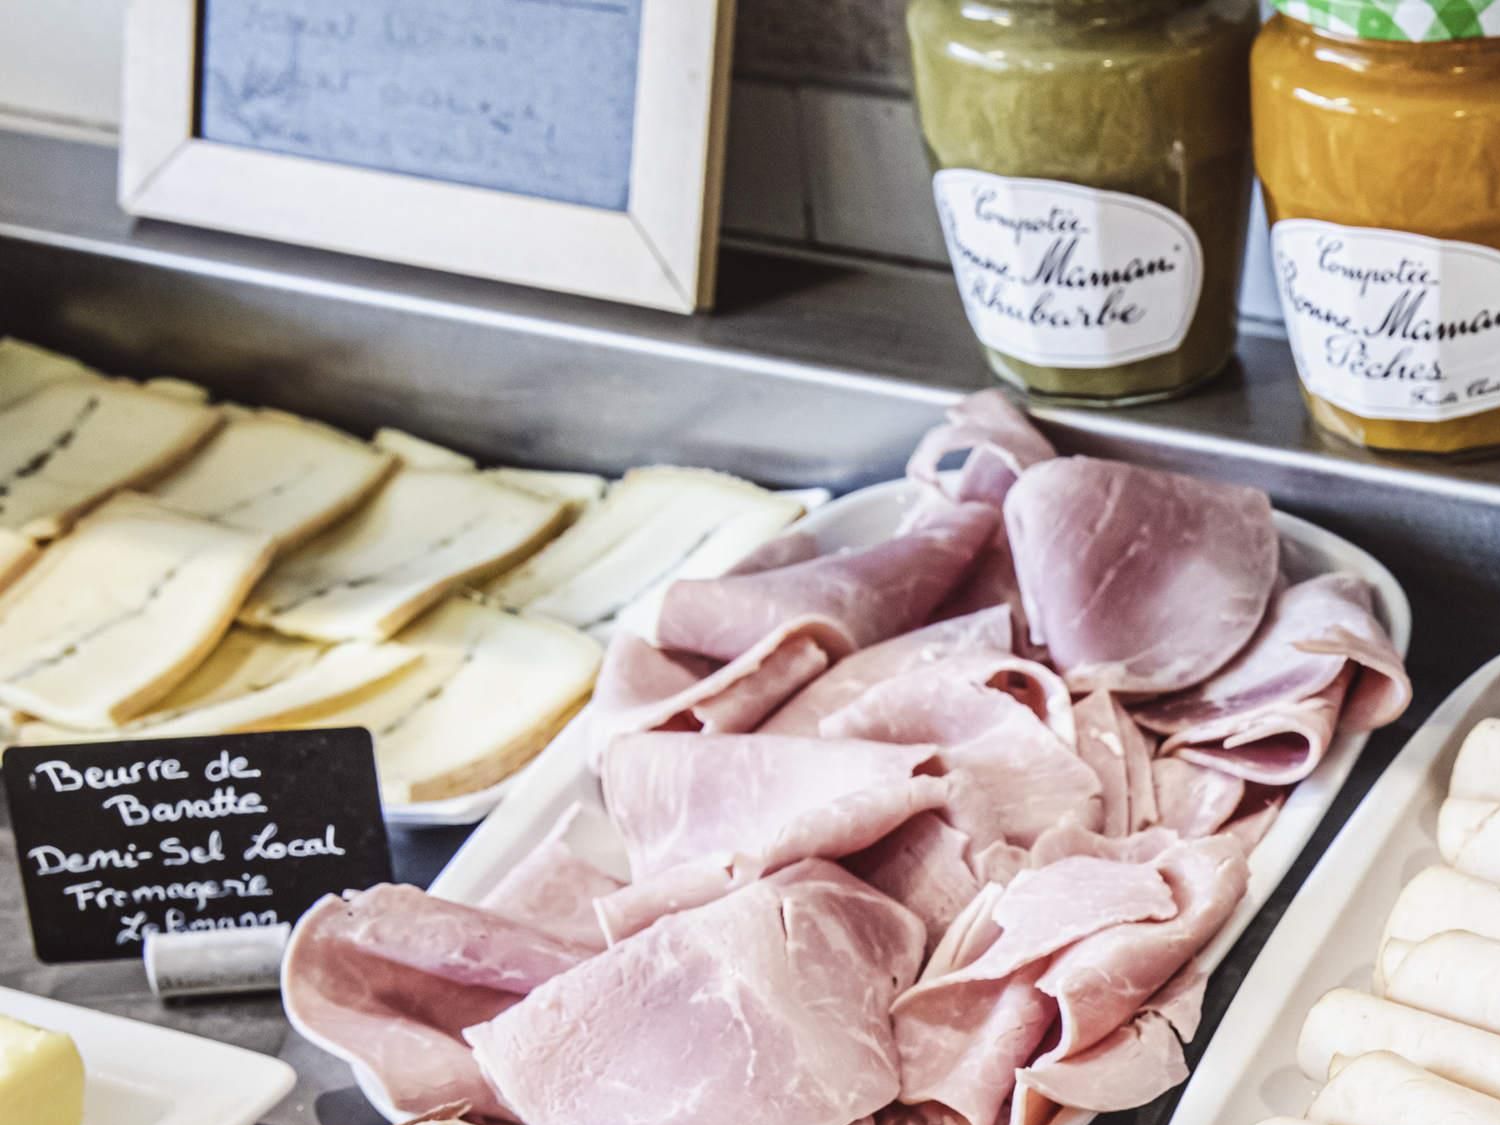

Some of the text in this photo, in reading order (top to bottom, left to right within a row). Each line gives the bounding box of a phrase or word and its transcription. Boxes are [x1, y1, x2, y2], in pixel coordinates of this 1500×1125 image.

[971, 281, 1147, 329] Rhubarbe
[1325, 334, 1448, 382] Pêches
[34, 750, 262, 792] Beurre de
[102, 786, 268, 827] Baratte
[243, 823, 346, 861] Local
[63, 873, 274, 911] Fromagerie
